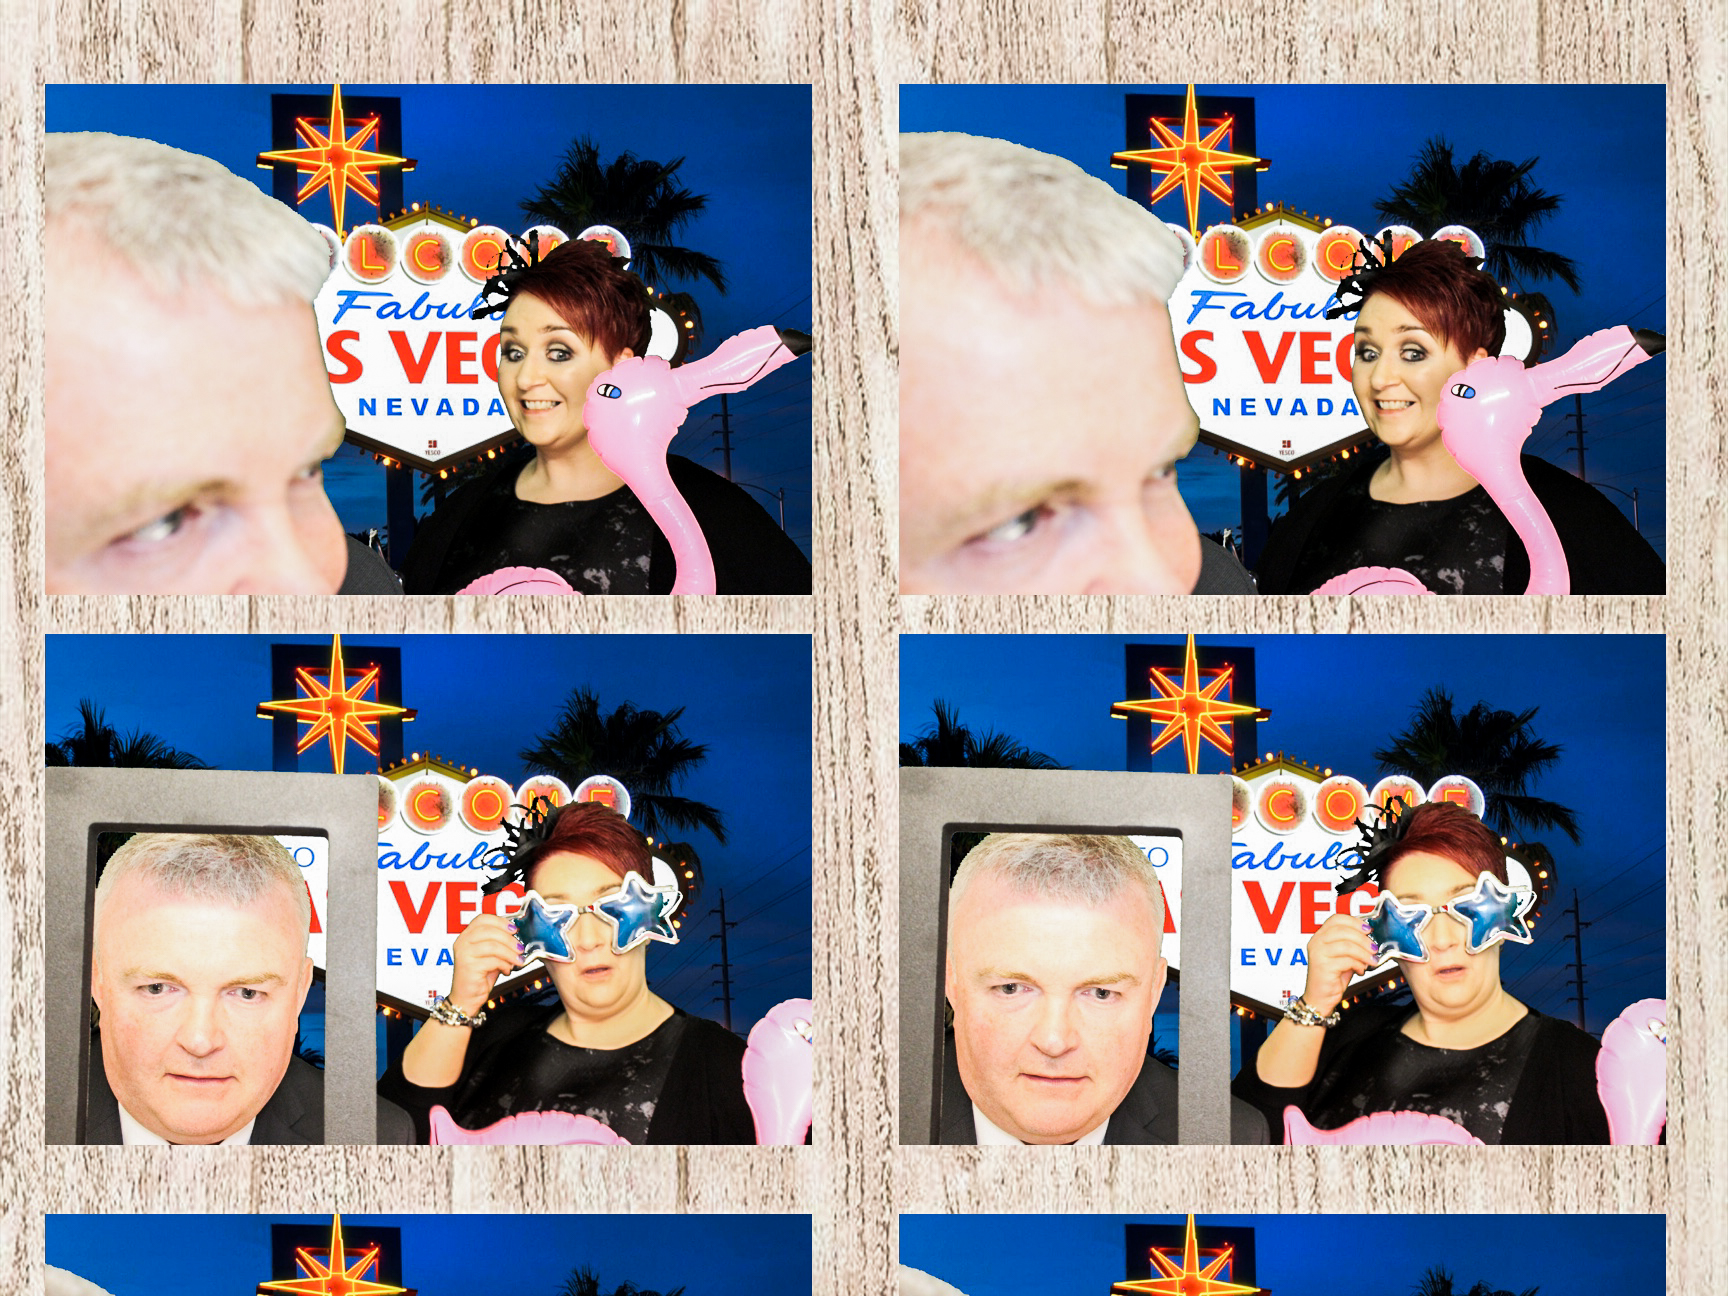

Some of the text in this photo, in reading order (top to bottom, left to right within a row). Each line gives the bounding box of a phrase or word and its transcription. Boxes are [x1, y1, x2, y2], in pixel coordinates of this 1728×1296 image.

[332, 289, 507, 325] Fabul
[1186, 289, 1361, 325] Fabul
[358, 397, 506, 417] NEVADA
[1212, 397, 1360, 417] NEVADA
